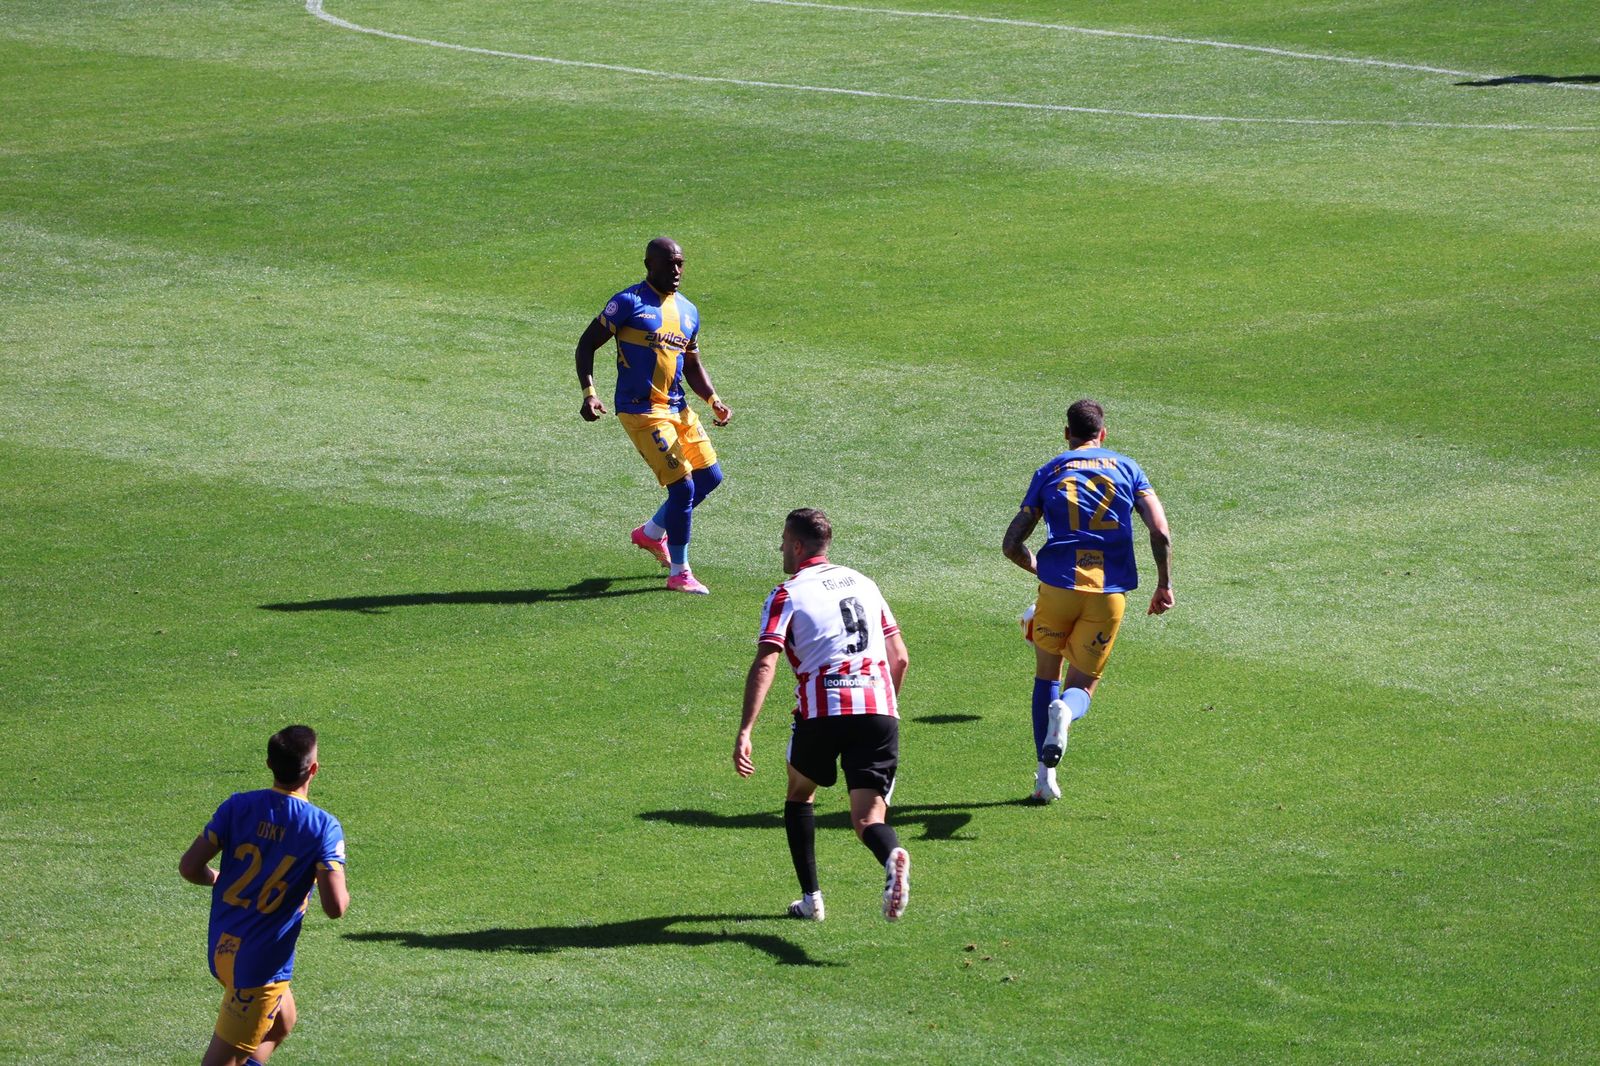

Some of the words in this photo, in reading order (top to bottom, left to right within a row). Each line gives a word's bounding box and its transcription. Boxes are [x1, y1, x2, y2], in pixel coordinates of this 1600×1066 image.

[652, 429, 668, 452] 5
[1057, 475, 1119, 531] 12
[839, 597, 868, 654] 9
[222, 843, 297, 914] 26
